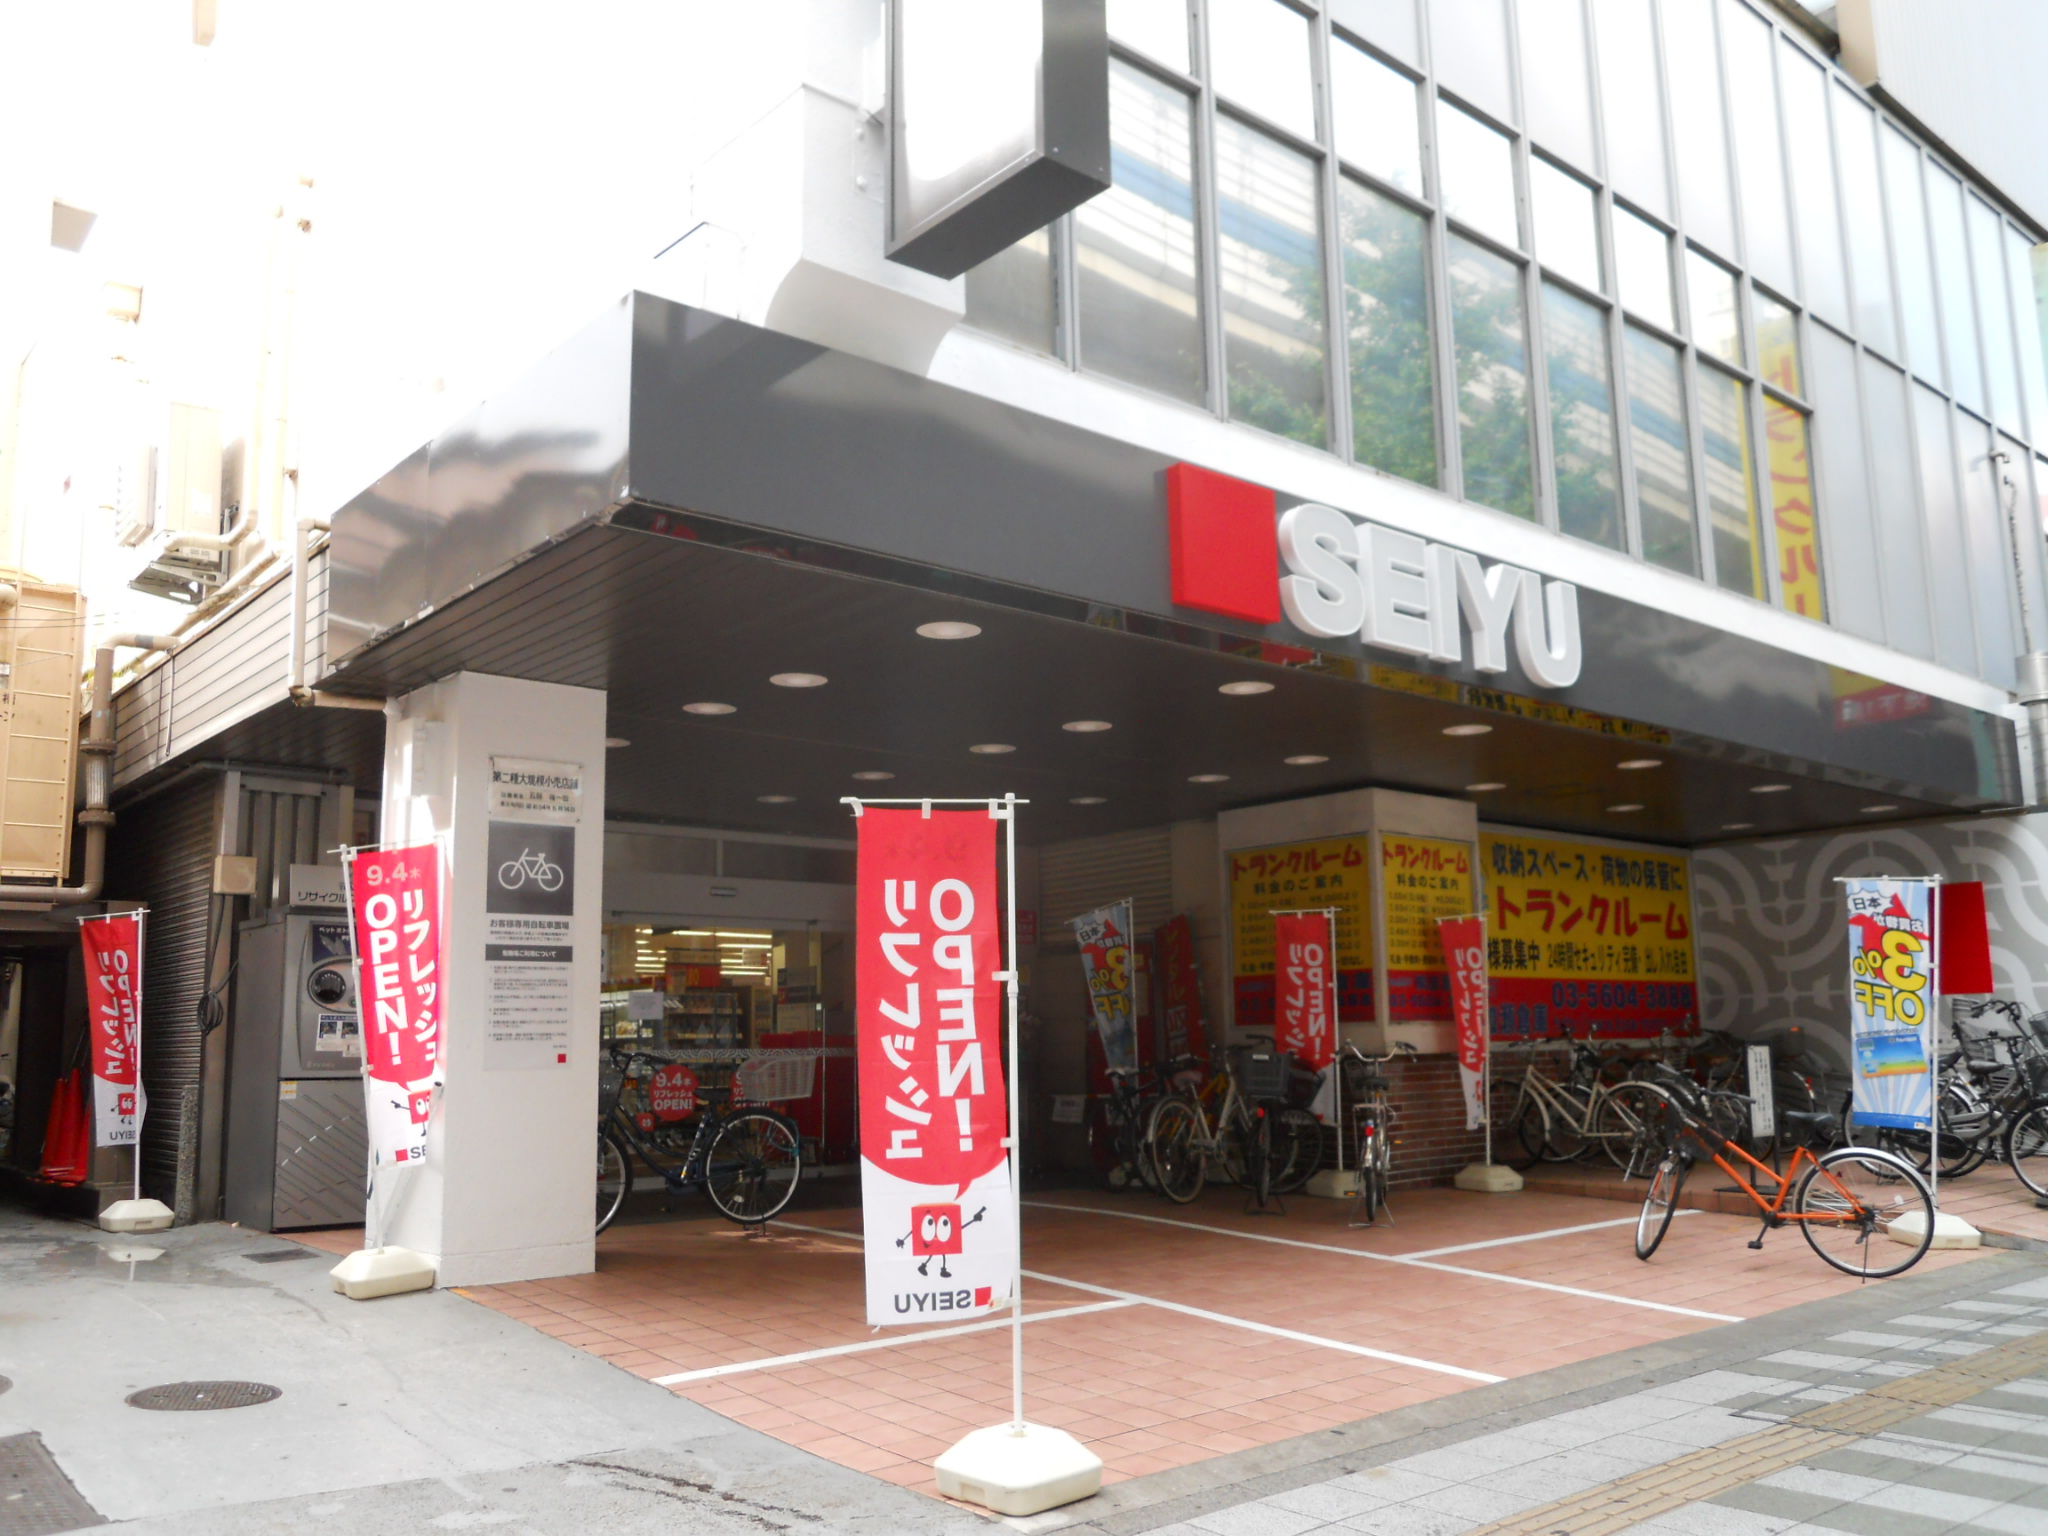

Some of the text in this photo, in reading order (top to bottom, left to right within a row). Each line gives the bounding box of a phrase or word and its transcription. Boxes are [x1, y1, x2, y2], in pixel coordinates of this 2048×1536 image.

[1278, 503, 1582, 689] SEIYU
[1232, 843, 1363, 881] トランクルーム
[1382, 840, 1469, 873] トランクルーム
[1497, 885, 1689, 940] トランクルーム
[365, 893, 409, 1066] OPEN!
[403, 888, 438, 1062] リフレッシュ
[653, 1098, 694, 1111] OPEN!
